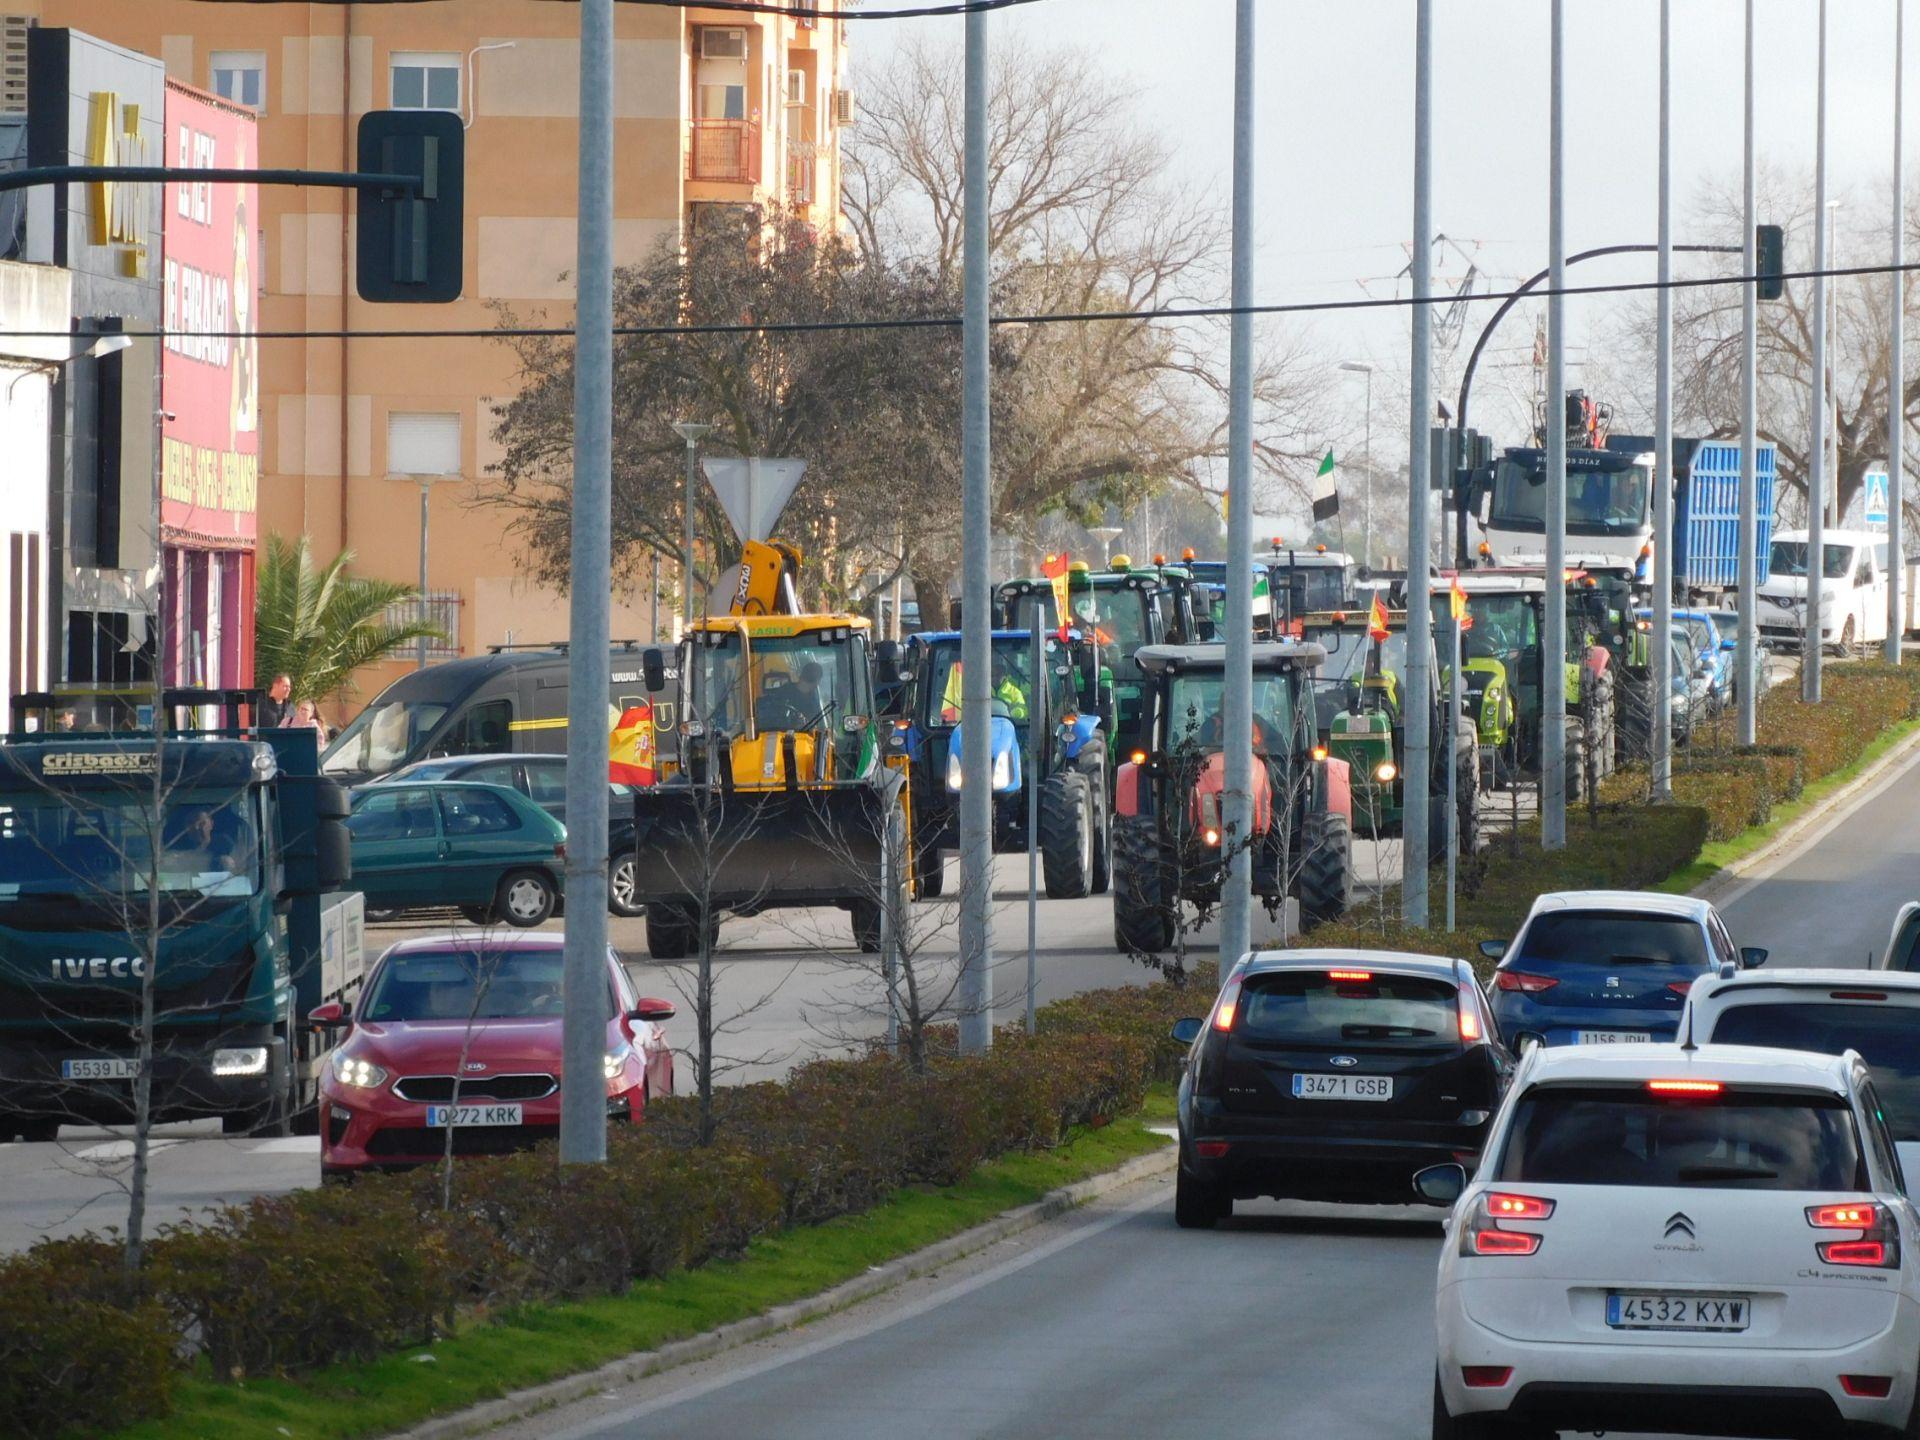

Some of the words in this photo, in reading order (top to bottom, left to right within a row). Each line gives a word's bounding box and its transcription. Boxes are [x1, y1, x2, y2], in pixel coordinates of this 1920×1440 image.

[178, 125, 190, 219] EL
[191, 131, 215, 227] REY
[72, 1062, 111, 1077] 5539
[1305, 1077, 1347, 1095] 3471
[1355, 1079, 1388, 1096] GSB
[438, 1107, 480, 1124] 0272
[485, 1106, 518, 1122] KRK
[1797, 1268, 1819, 1278] C4
[1624, 1300, 1687, 1321] 4532
[1696, 1301, 1743, 1323] KXW
